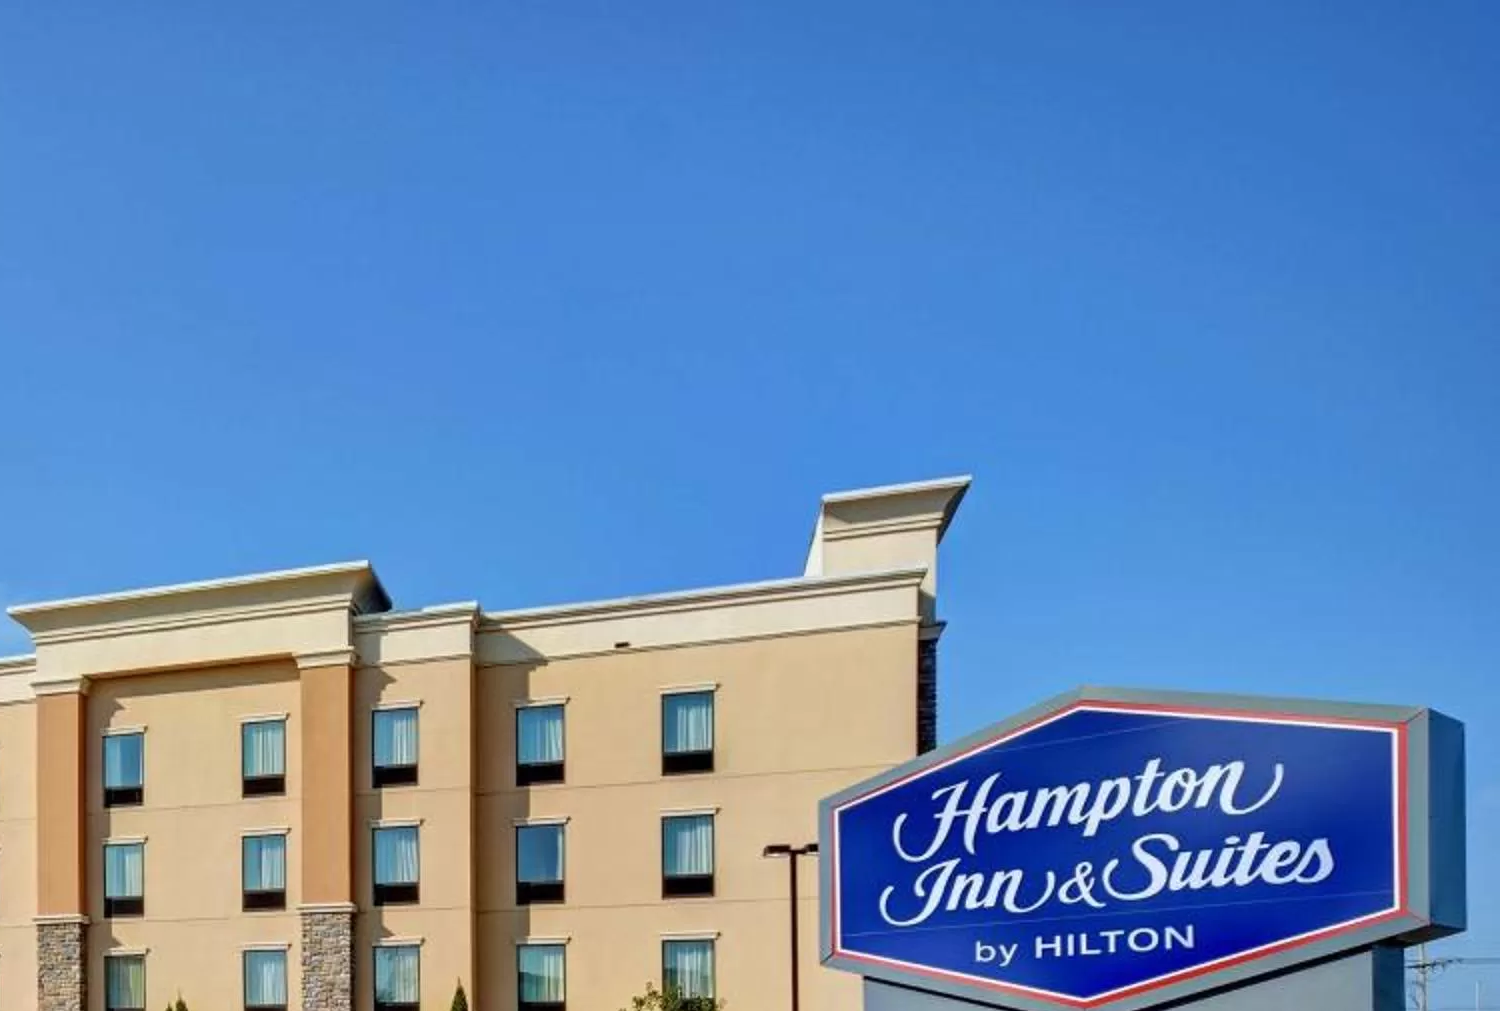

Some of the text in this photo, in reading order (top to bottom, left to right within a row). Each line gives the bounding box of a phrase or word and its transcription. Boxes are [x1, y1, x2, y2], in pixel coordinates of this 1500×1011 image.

[893, 757, 1284, 863] Hampton
[879, 832, 1335, 926] Inn & Suites
[975, 924, 1195, 967] by HILTON
